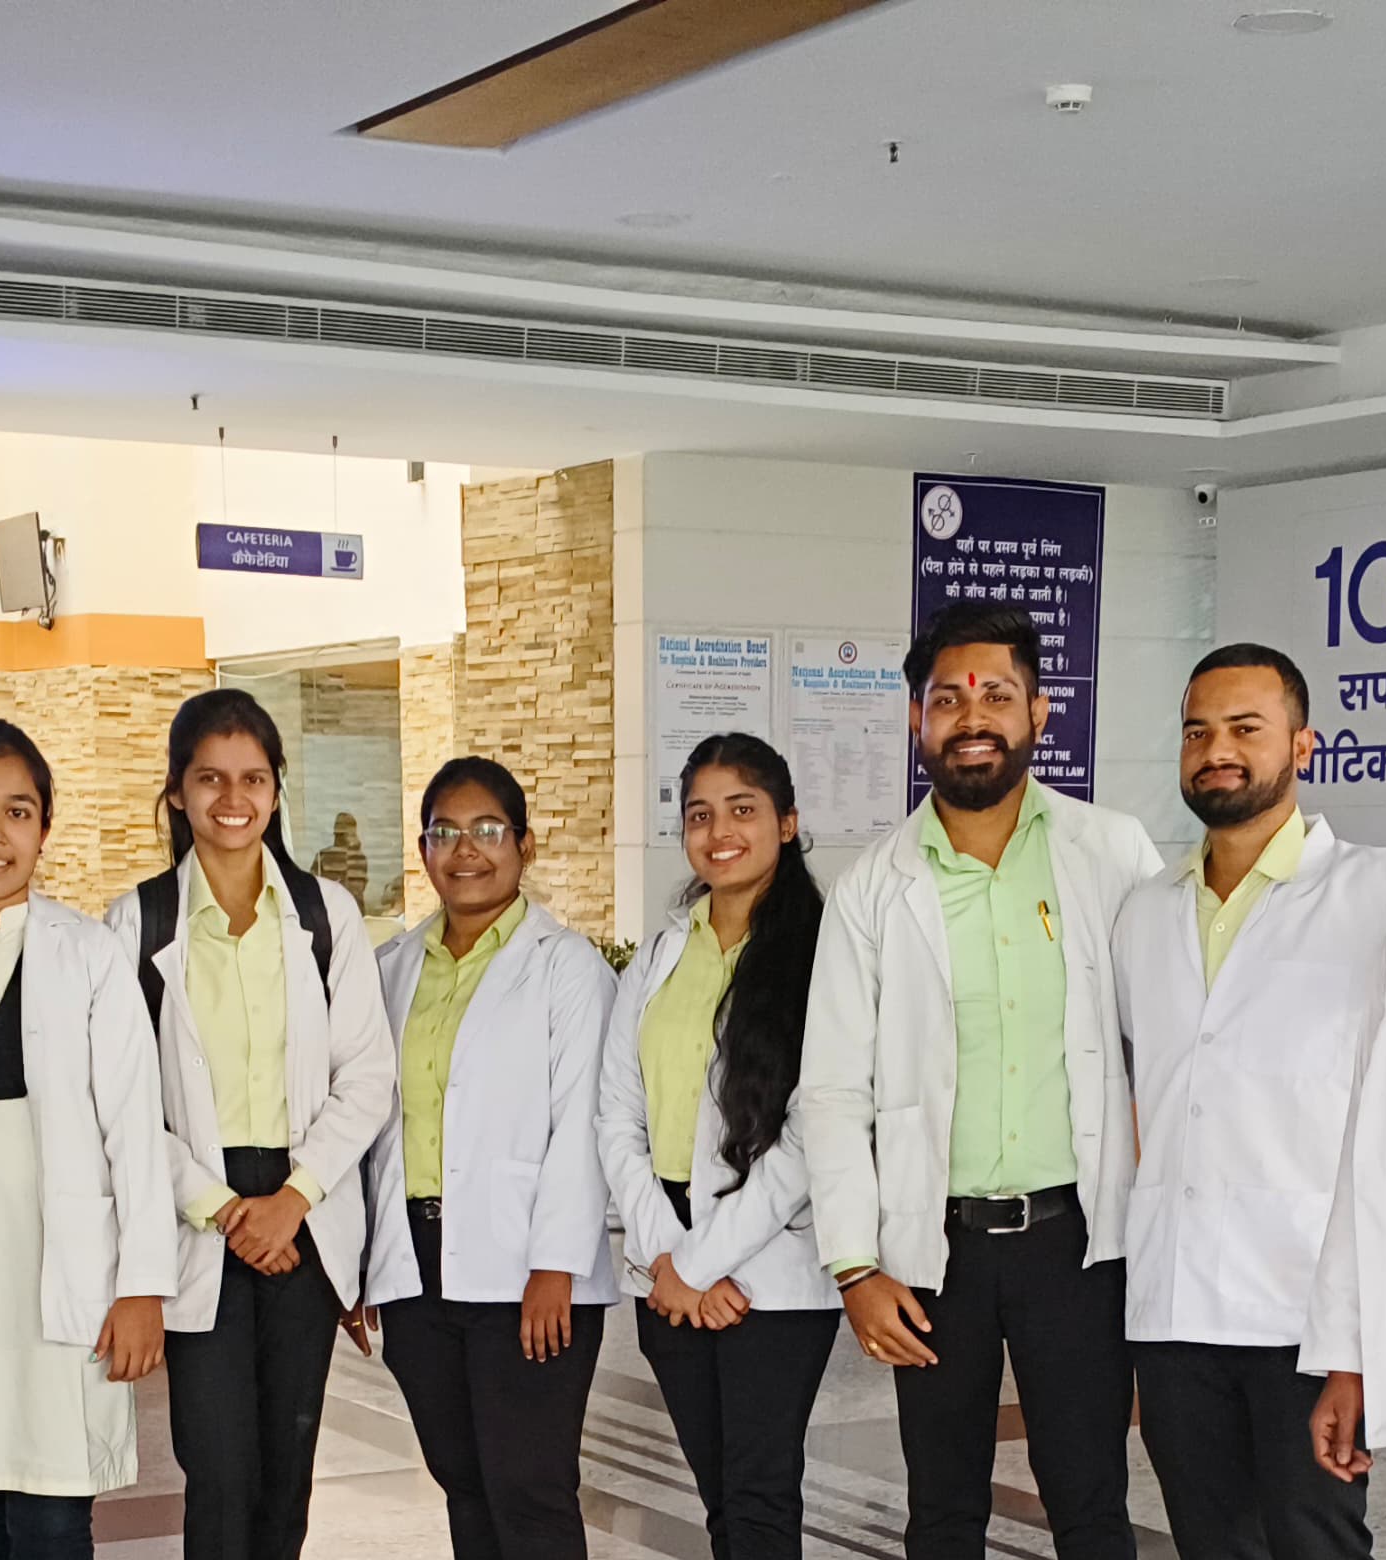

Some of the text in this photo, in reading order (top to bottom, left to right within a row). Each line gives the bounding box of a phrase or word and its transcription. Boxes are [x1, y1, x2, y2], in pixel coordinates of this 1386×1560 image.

[226, 531, 293, 548] CAFETERIA
[978, 539, 991, 552] पर
[1041, 538, 1062, 557] लिंग
[982, 559, 1006, 577] पहले
[1044, 566, 1056, 579] या
[946, 580, 960, 598] की
[1011, 584, 1026, 600] की
[1029, 585, 1052, 602] जाती
[1029, 611, 1055, 627] पराध
[1039, 686, 1075, 698] INATION
[1041, 750, 1054, 761] OF
[1055, 750, 1071, 761] THE
[1028, 766, 1086, 778] DER THE LAW
